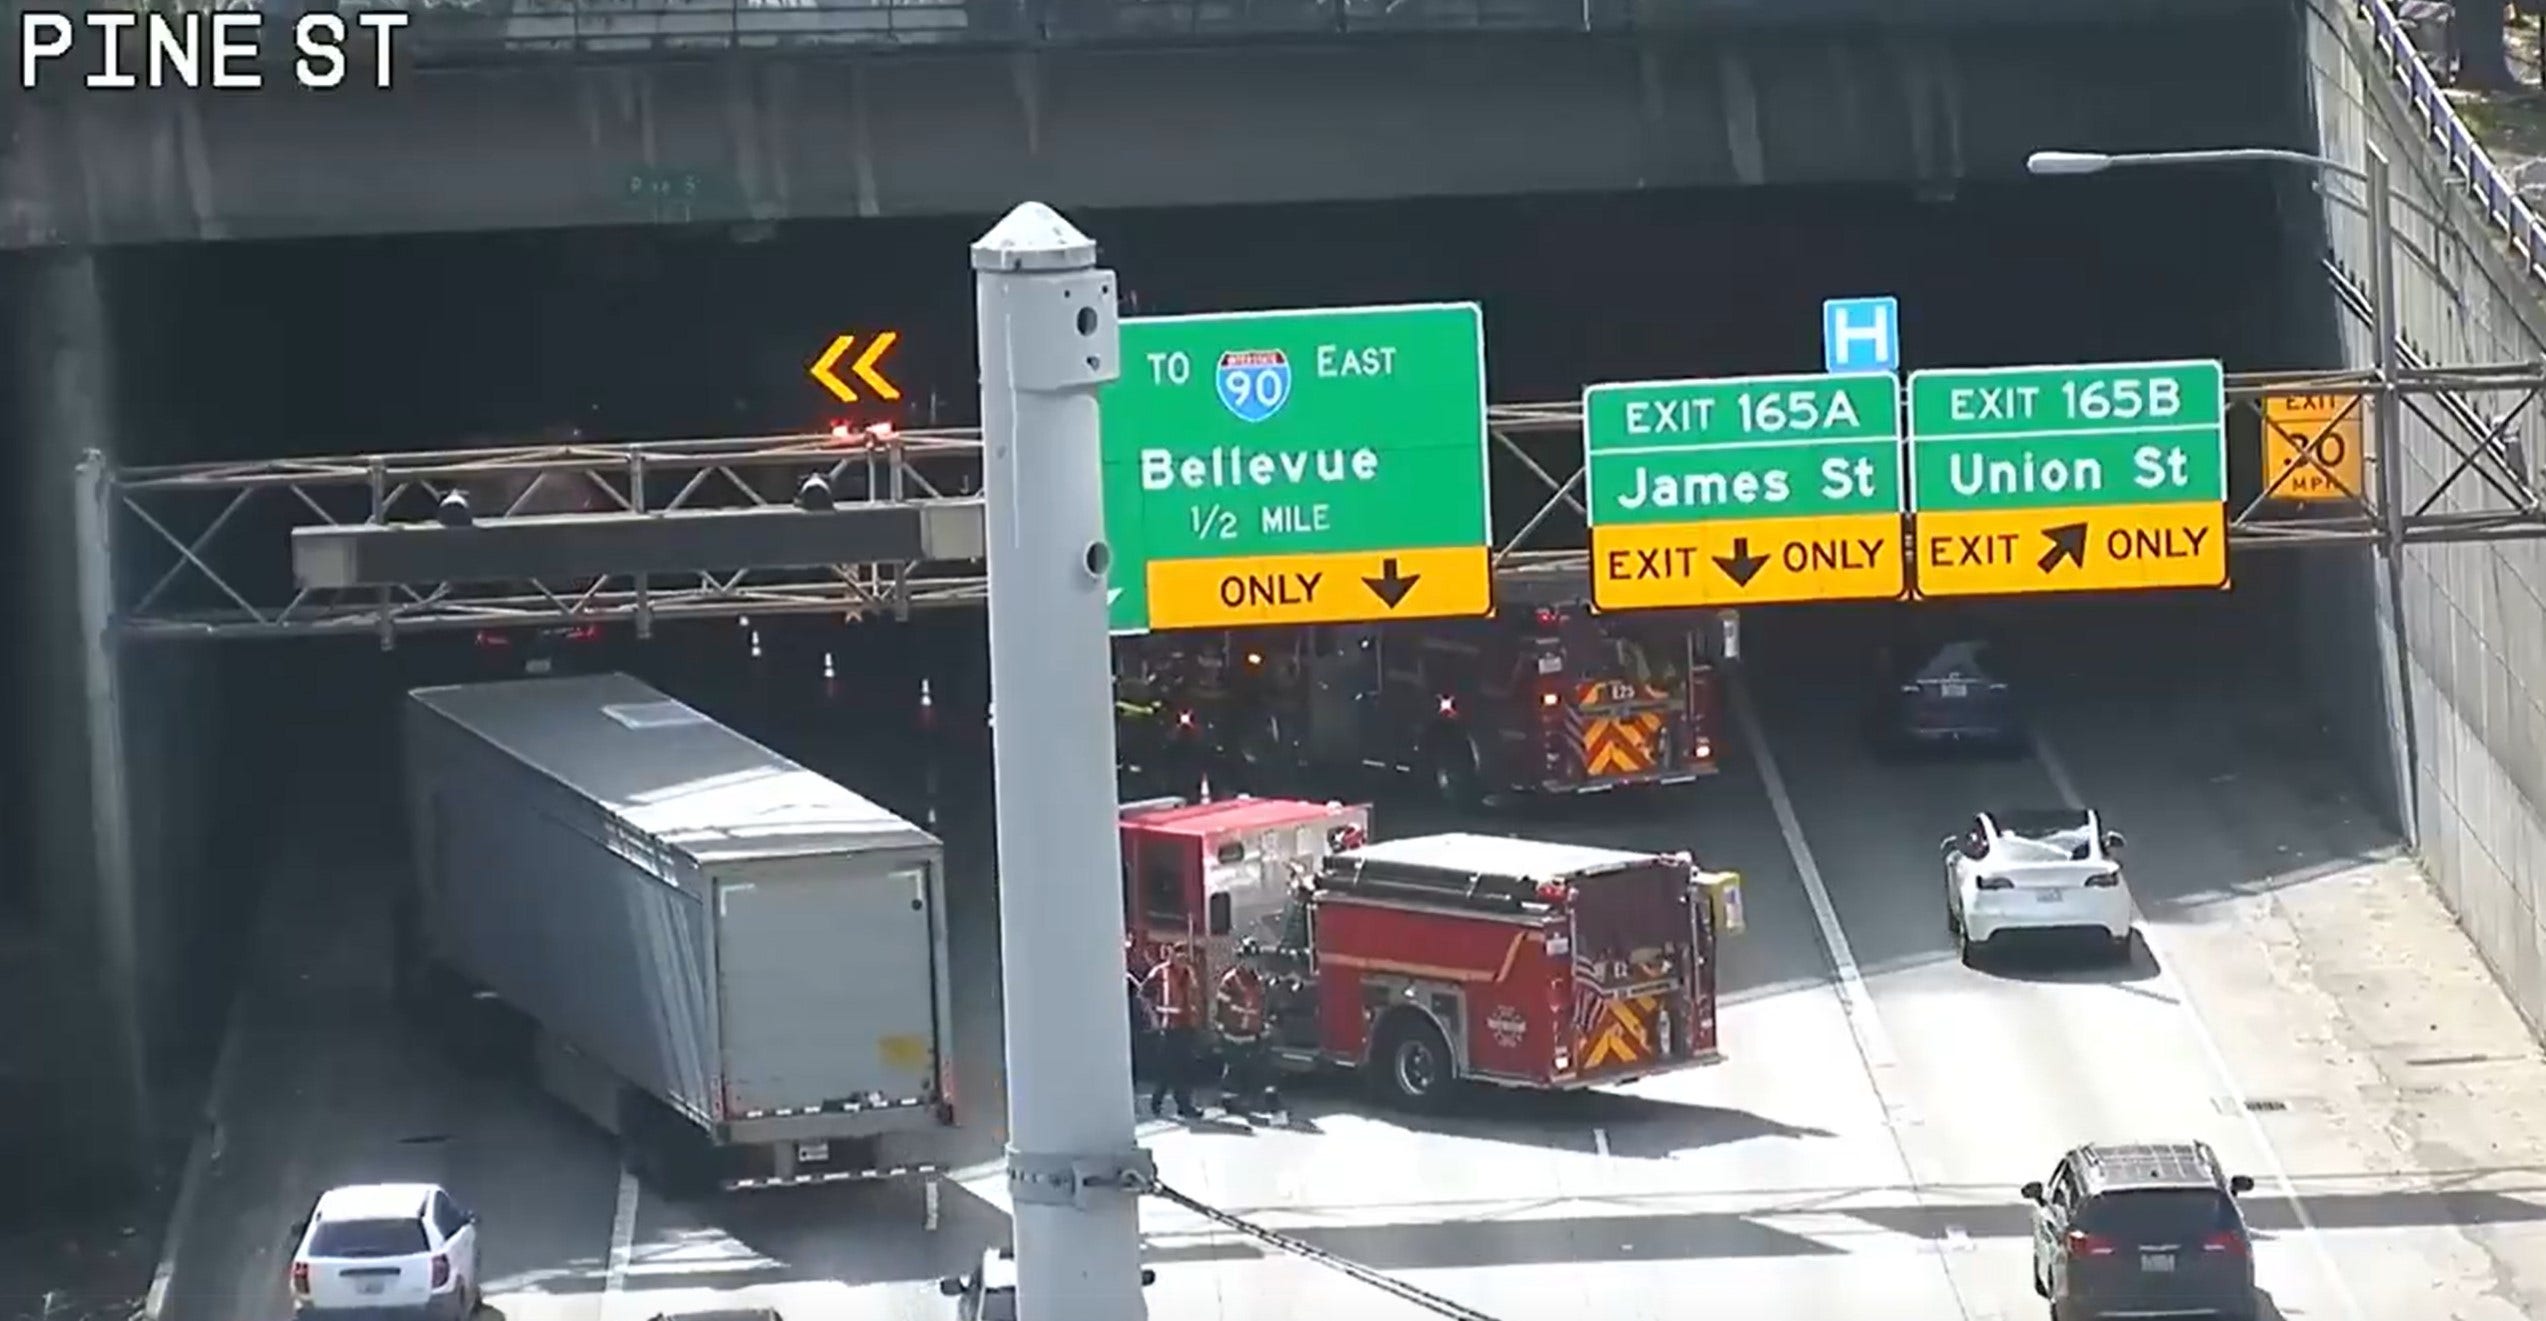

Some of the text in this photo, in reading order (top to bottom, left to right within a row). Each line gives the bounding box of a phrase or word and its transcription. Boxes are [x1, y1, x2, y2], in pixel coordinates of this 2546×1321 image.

[1834, 304, 1890, 365] H
[1147, 344, 1397, 407] TO 90 EAST
[1626, 389, 1860, 435] EXIT 165A
[1950, 377, 2181, 420] EXIT 165B
[1141, 445, 1378, 490] Bellevue
[1617, 455, 1876, 508] James St
[1950, 445, 2188, 495] Union St
[1190, 504, 1331, 540] 1/2 MILE
[1608, 537, 1885, 580] EXIT ONLY
[1931, 526, 2209, 567] EXIT ONLY
[1220, 571, 1323, 608] ONLY
